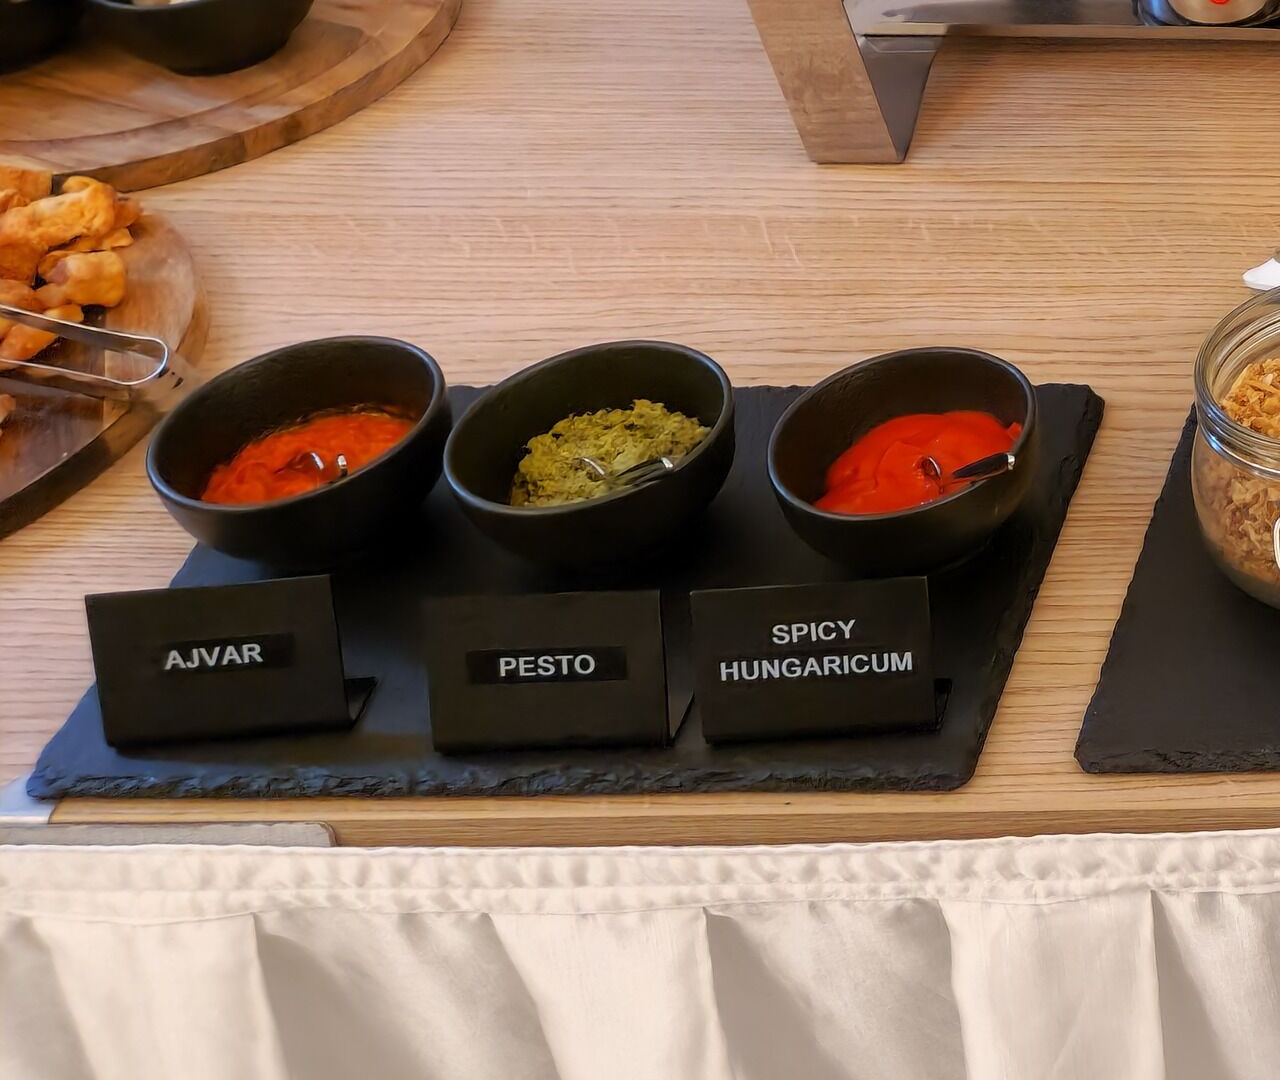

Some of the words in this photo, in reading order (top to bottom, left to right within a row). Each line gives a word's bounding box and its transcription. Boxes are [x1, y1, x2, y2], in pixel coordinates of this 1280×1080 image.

[771, 619, 856, 645] SPICY
[163, 643, 264, 671] AJVAR
[498, 653, 597, 678] PESTO
[719, 651, 914, 682] HUNGARICUM
